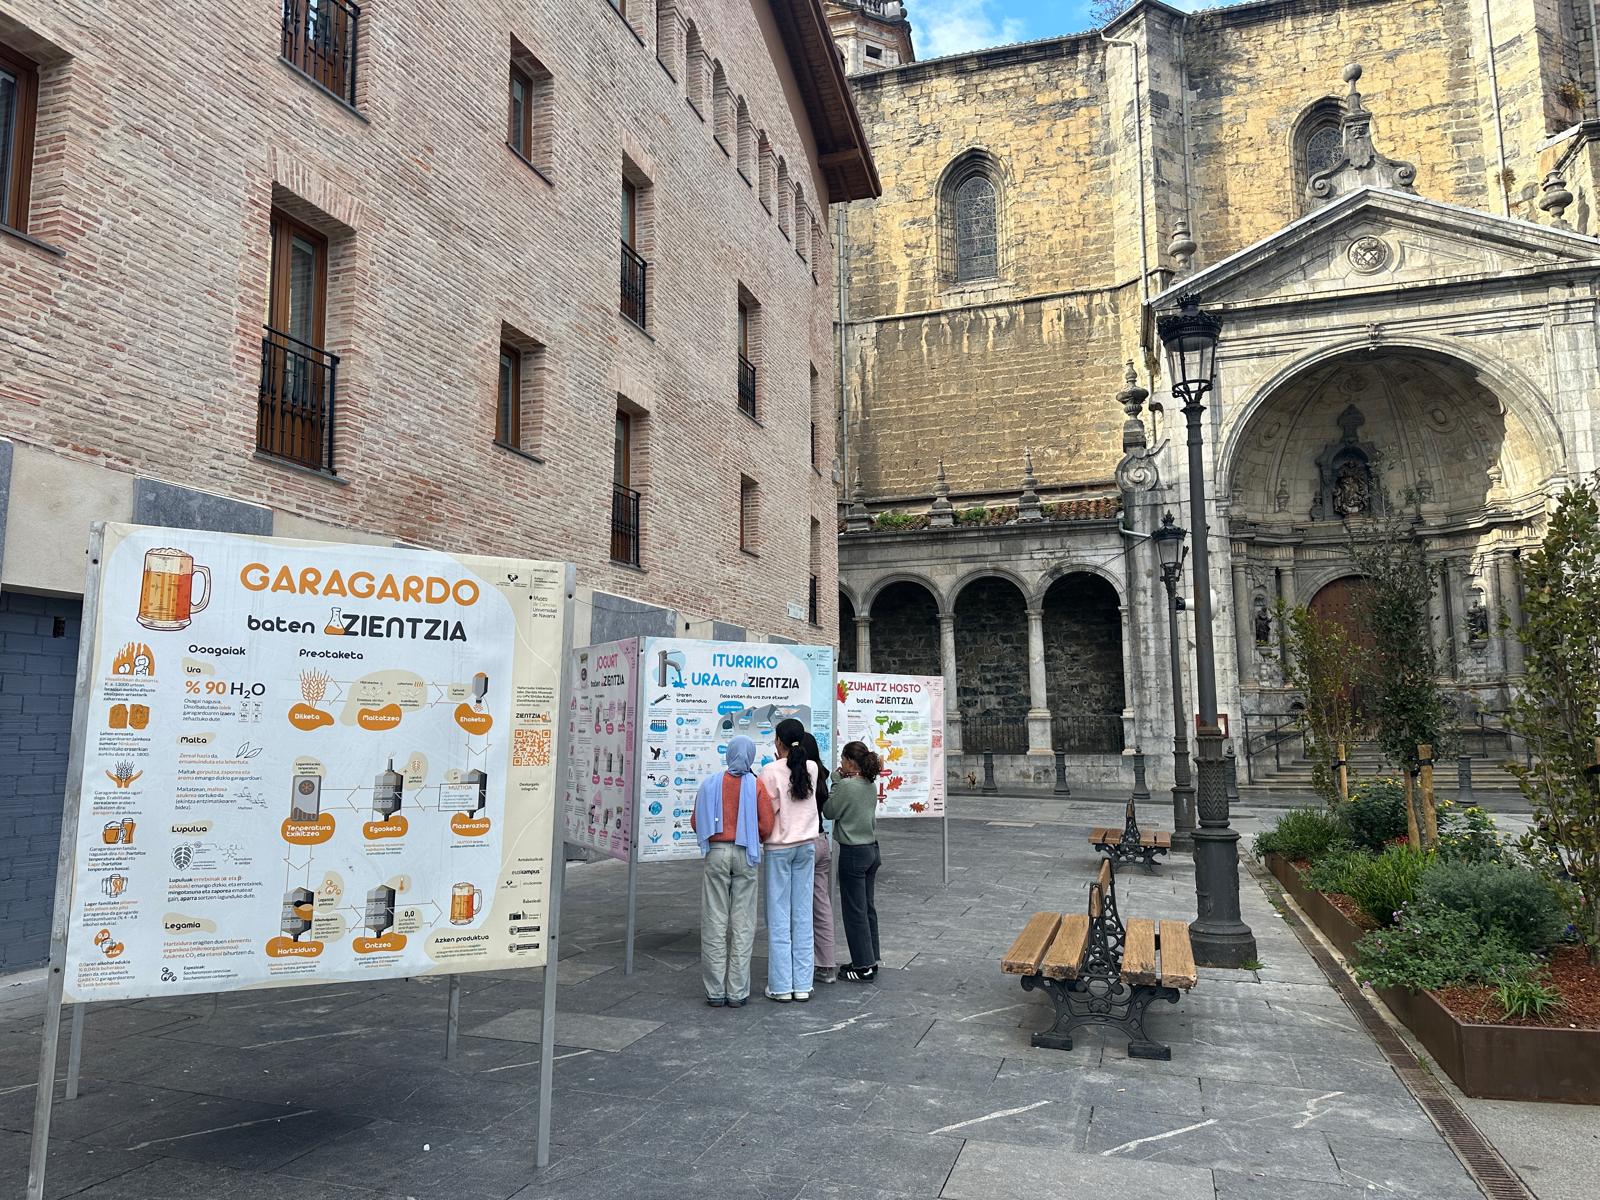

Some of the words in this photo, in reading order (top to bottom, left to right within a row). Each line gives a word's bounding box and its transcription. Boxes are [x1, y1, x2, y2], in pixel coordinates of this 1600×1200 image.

[240, 563, 479, 606] GARAGARDO
[248, 614, 314, 634] baten
[341, 614, 467, 642] ZIENTZIA
[188, 644, 246, 656] Osagaiak
[299, 649, 364, 660] Prestaketa
[596, 654, 618, 672] JOGURT
[712, 654, 778, 669] ITURRIKO
[692, 672, 737, 687] URAren
[748, 676, 800, 689] ZIENTZIA
[186, 680, 200, 694] %
[205, 681, 226, 695] 90
[848, 682, 887, 692] ZUHAITZ
[890, 683, 921, 693] HOSTO
[879, 697, 914, 705] ZIENTZIA
[165, 921, 200, 930] Legamia
[456, 935, 489, 943] produktua
